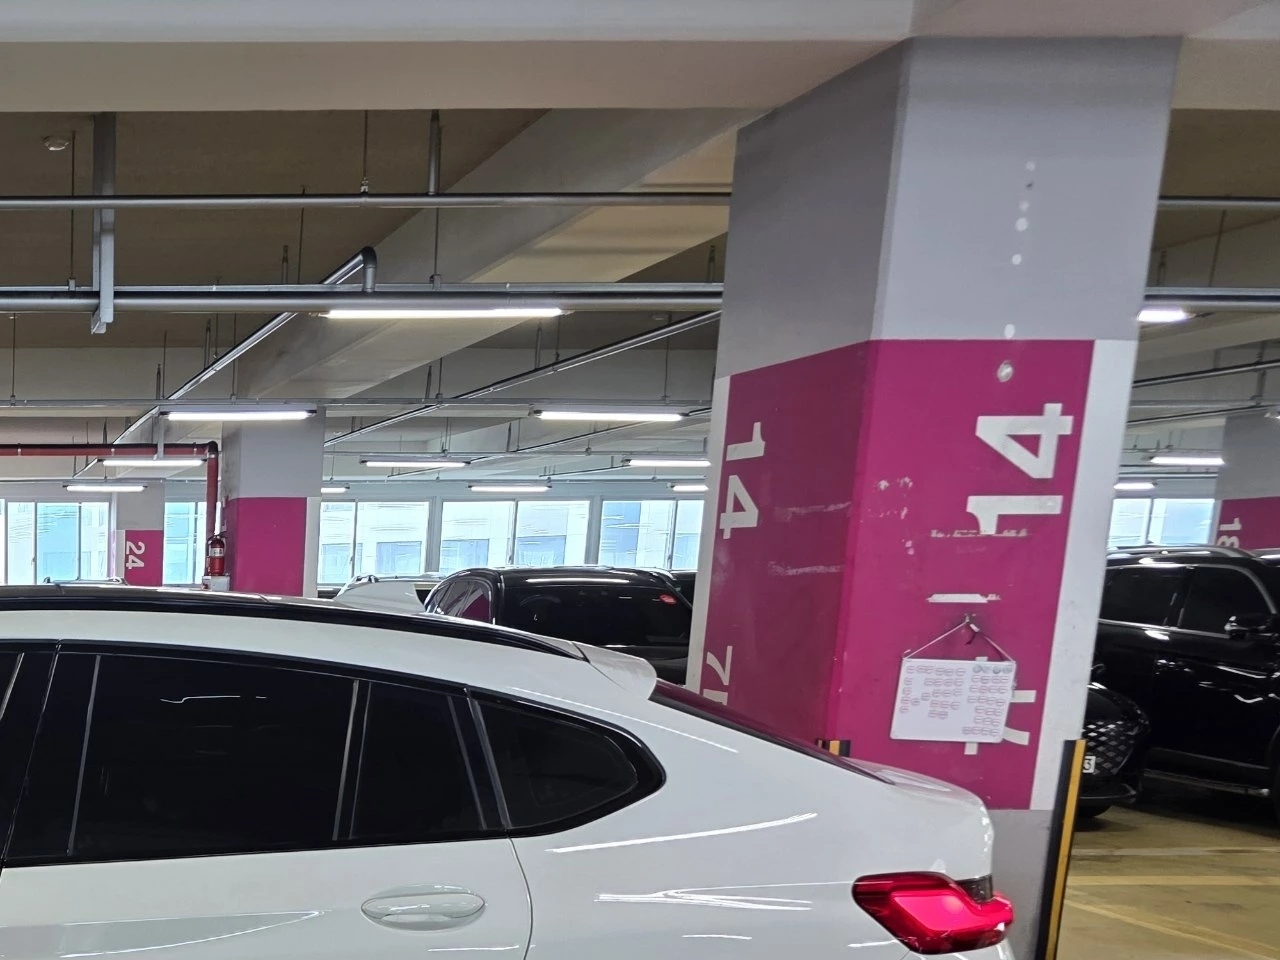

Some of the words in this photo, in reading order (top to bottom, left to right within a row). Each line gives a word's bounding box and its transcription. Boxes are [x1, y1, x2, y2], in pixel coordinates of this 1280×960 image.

[720, 421, 765, 539] 14
[966, 403, 1074, 535] 14
[125, 541, 145, 570] 24
